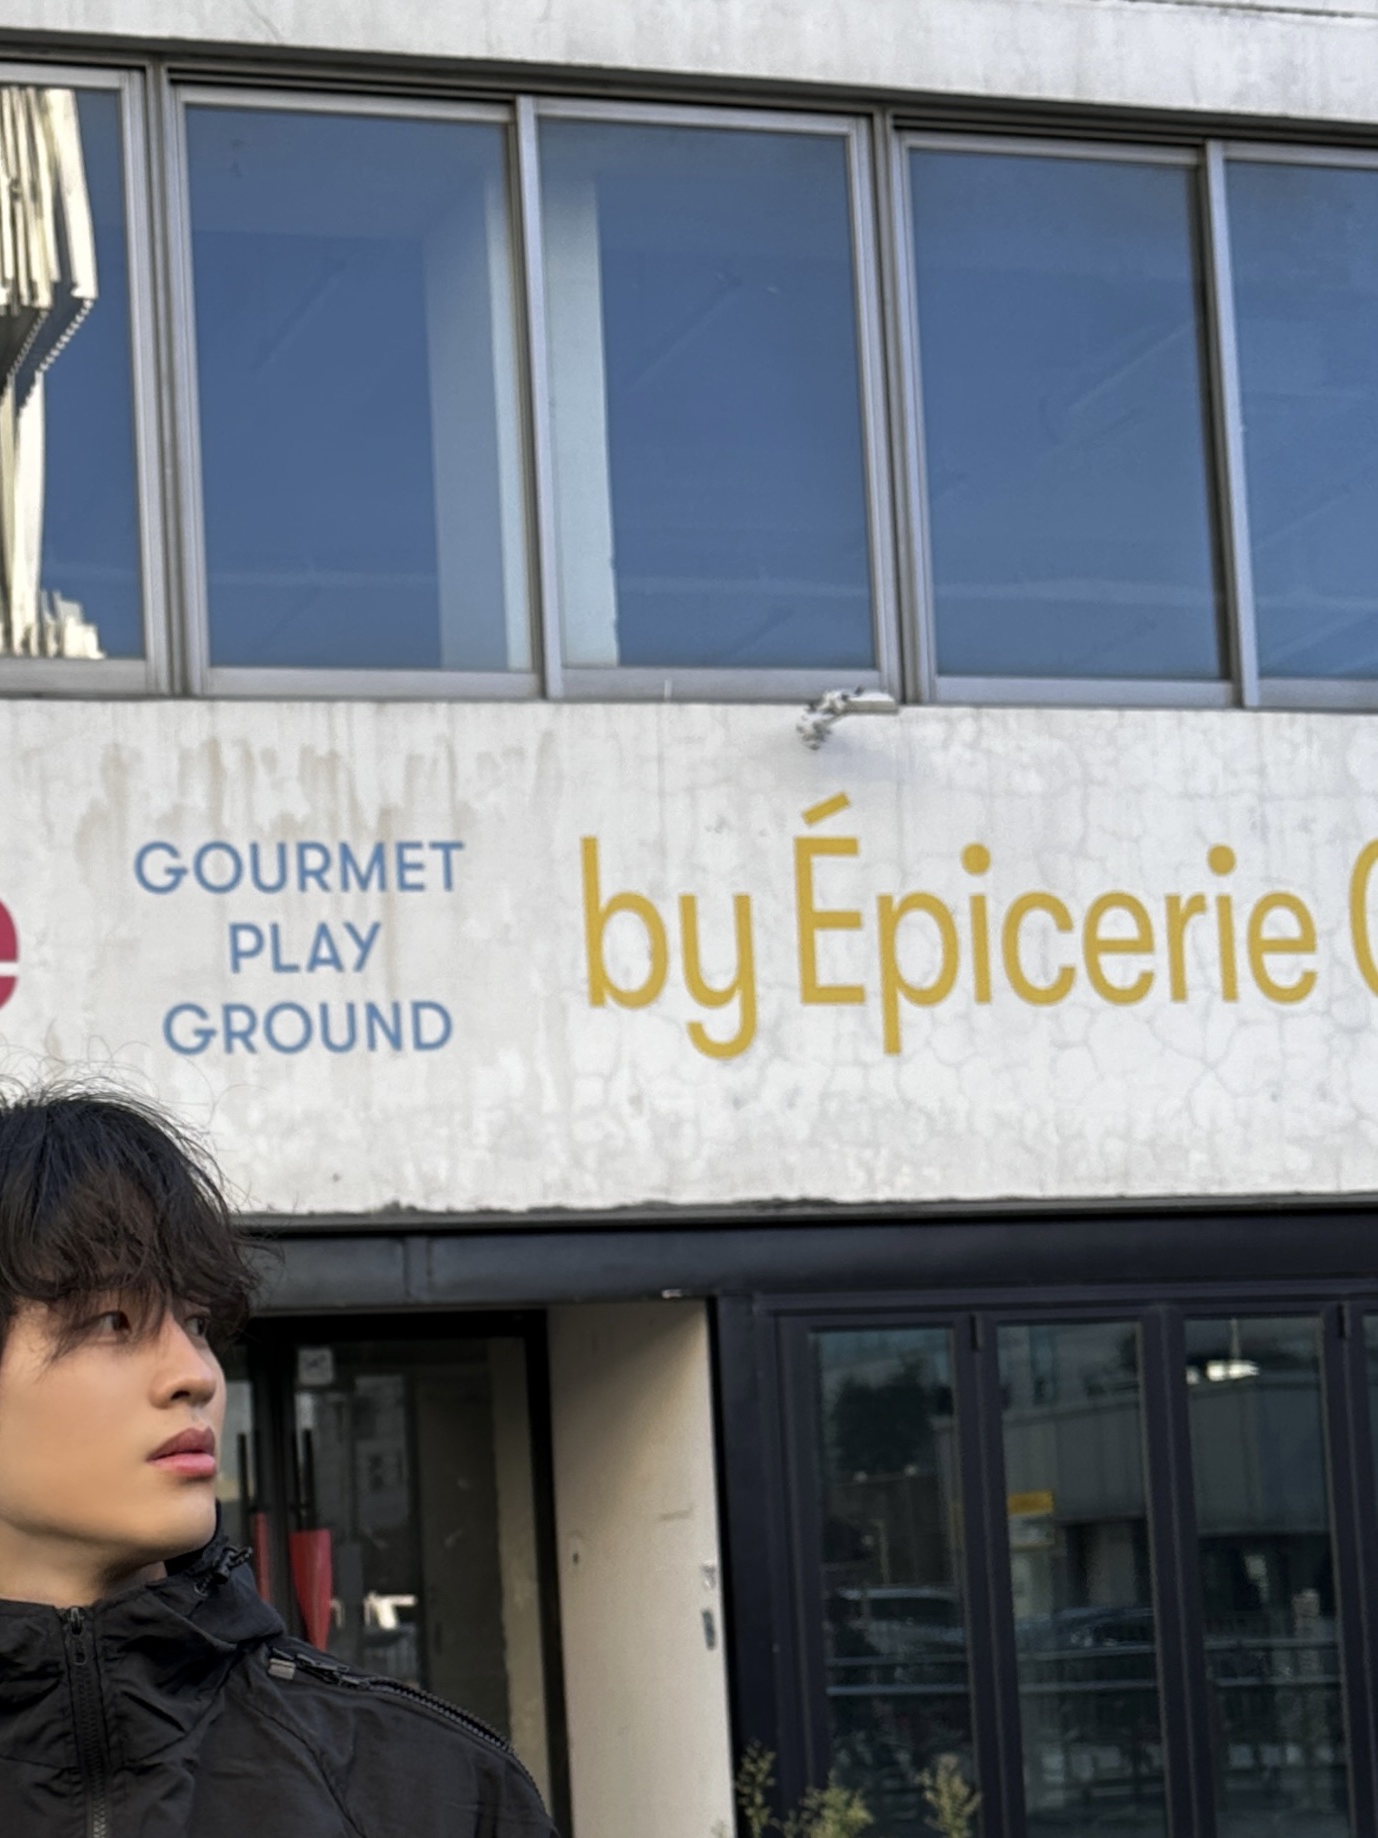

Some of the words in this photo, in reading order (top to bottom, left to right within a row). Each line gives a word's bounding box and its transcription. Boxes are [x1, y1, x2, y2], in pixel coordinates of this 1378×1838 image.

[133, 841, 464, 896] GOURMET
[228, 922, 381, 974] PLAY
[580, 836, 758, 1059] by
[794, 791, 1318, 1055] Épicerie
[162, 1001, 453, 1056] GROUND
